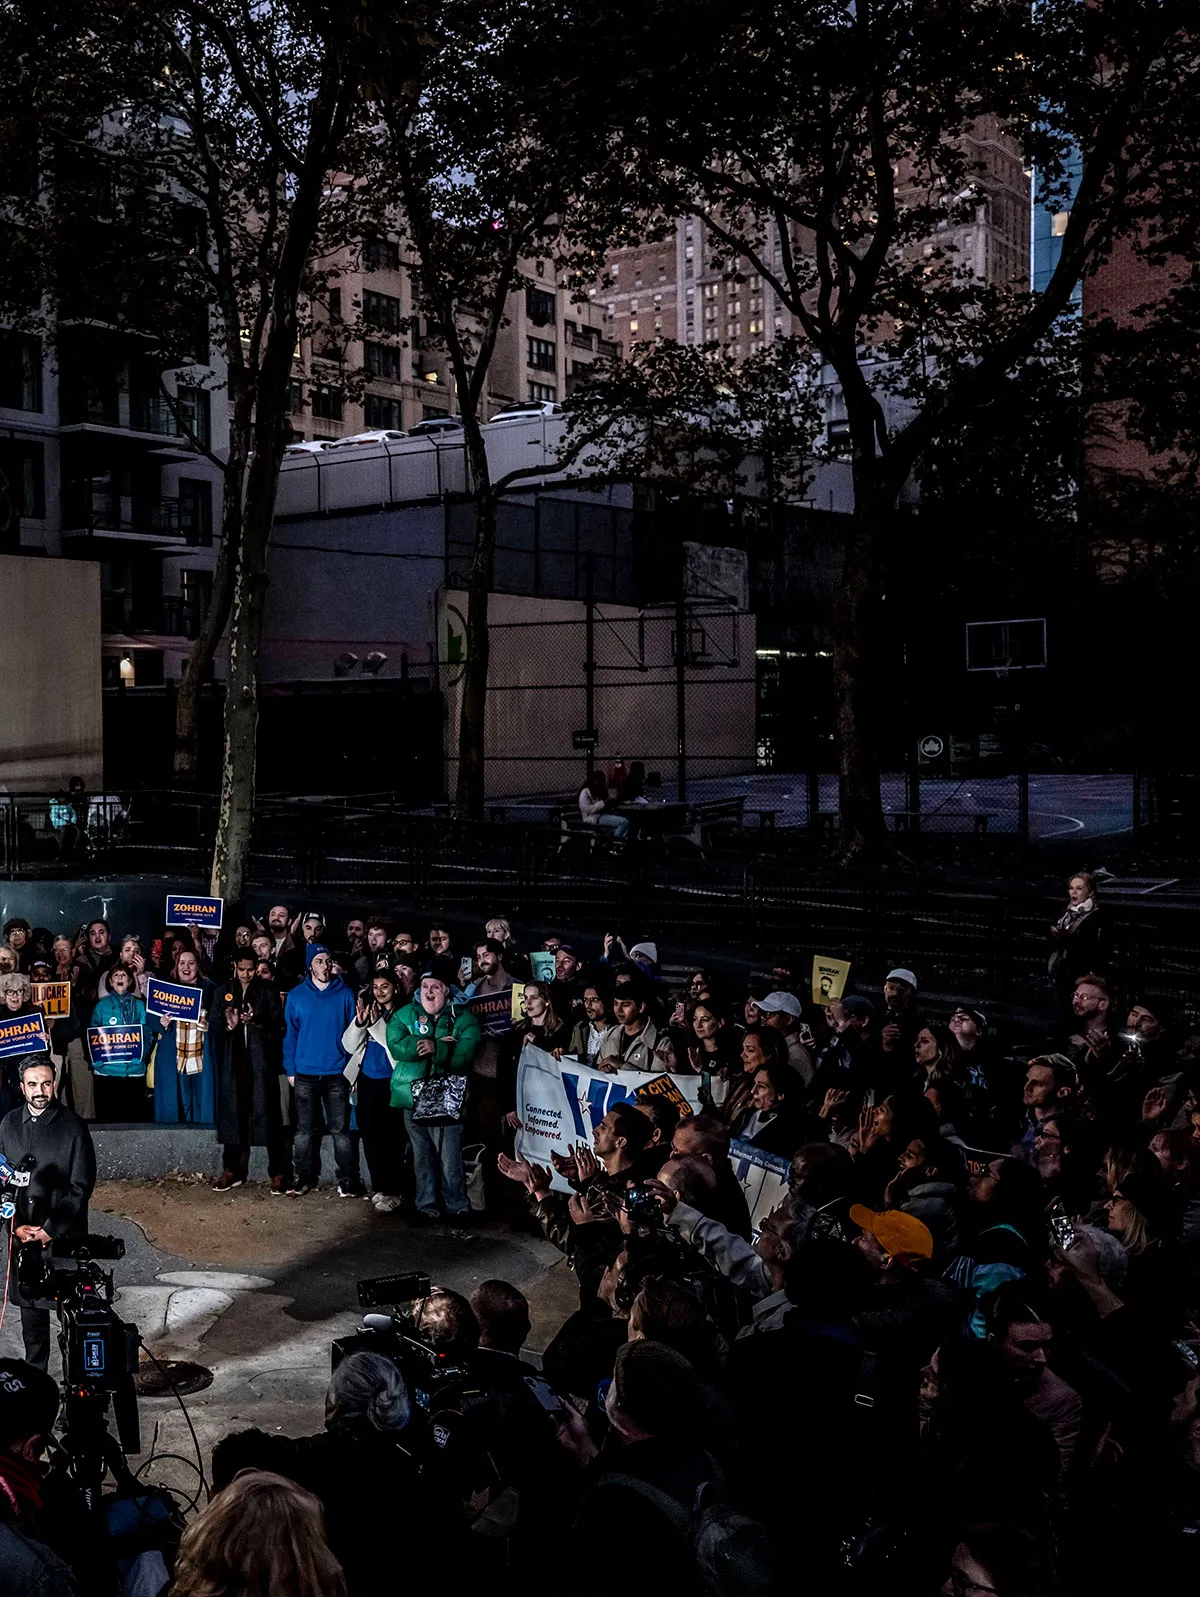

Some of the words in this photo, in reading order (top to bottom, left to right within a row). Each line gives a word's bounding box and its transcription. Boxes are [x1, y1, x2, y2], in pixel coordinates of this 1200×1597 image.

[173, 903, 217, 913] ZOHRAN
[152, 989, 195, 1006] ZOHRAN
[90, 1032, 140, 1046] ZOHRAN
[648, 1075, 673, 1095] CITY
[525, 1103, 563, 1119] Connected.
[527, 1114, 559, 1129] Informed.
[525, 1123, 562, 1140] Empowered.
